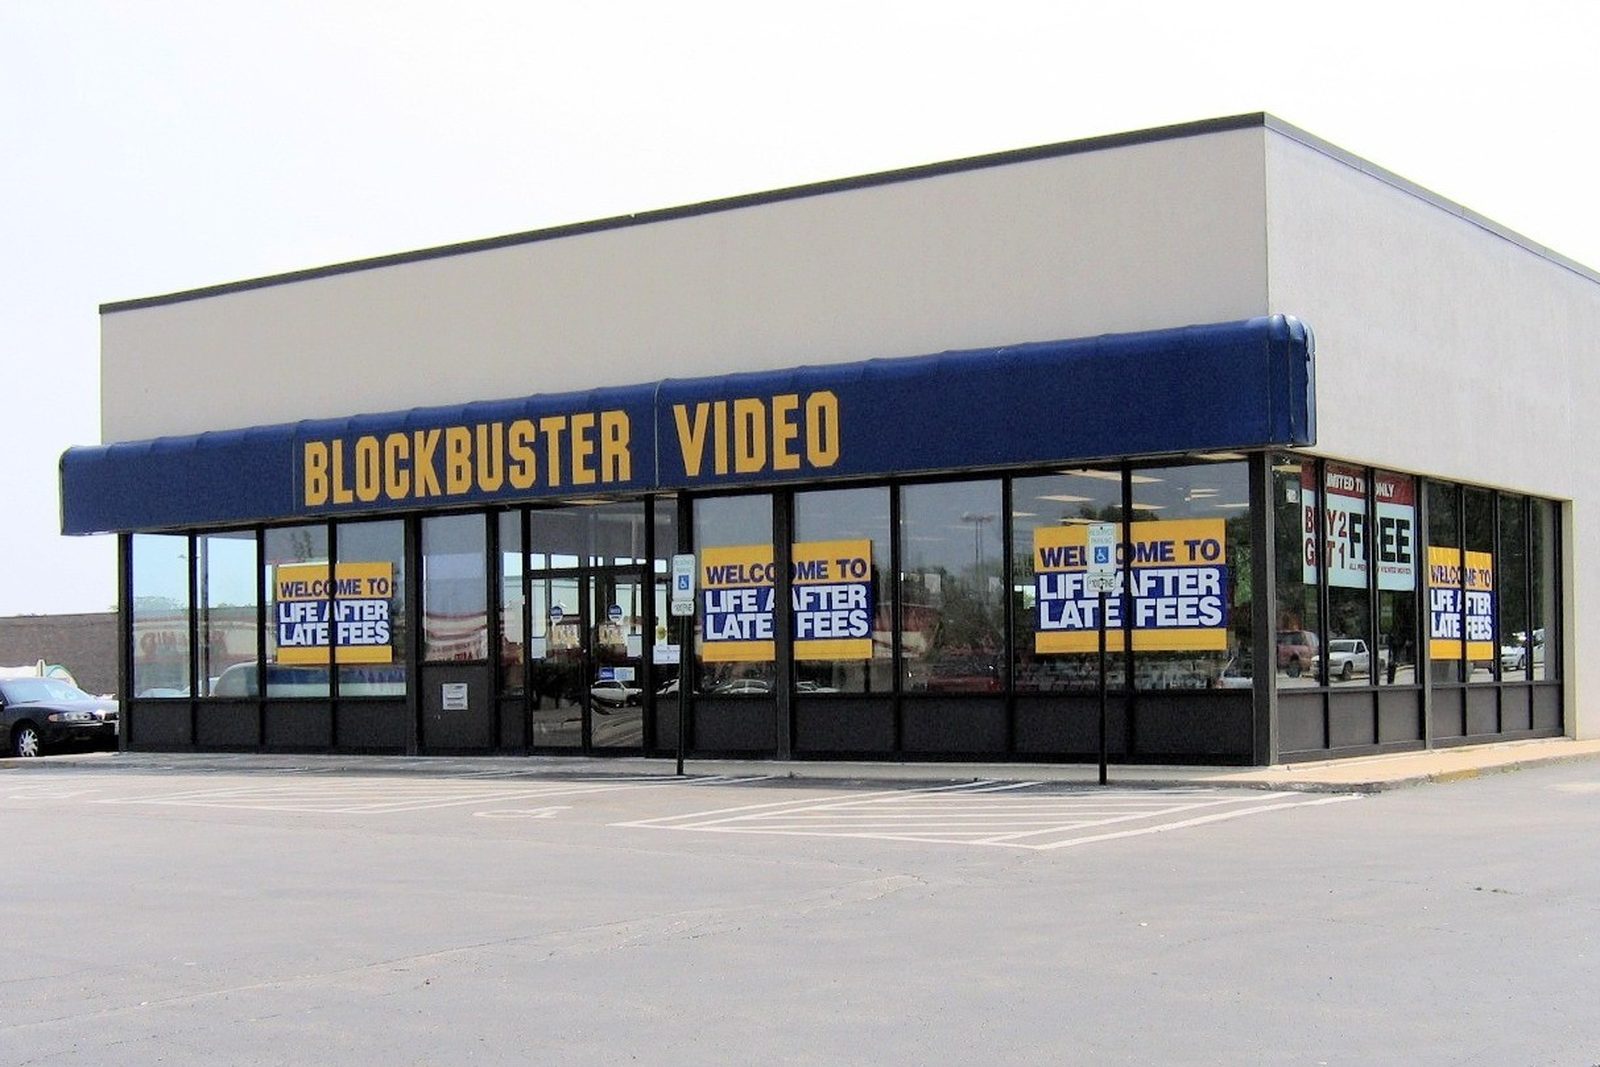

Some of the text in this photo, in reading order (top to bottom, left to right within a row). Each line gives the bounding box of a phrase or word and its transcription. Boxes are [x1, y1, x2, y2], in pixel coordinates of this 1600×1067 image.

[304, 391, 840, 506] BLOCKBUSTER VIDEO
[1305, 505, 1347, 538] BY 2
[1040, 538, 1221, 567] WELOME TO
[1305, 537, 1345, 569] GT 1
[706, 558, 867, 584] WELCOME TO
[1111, 568, 1221, 597] AFTER
[1479, 569, 1491, 588] TO
[368, 578, 389, 596] TO
[705, 584, 867, 613] LIFE AFTER
[1431, 589, 1454, 612] LIFE
[280, 600, 389, 622] LIFE AFTER
[706, 609, 869, 640] LATE FEES
[1040, 596, 1222, 629] LATE FEES
[280, 621, 390, 646] LATE FEES
[1431, 612, 1492, 640] LATE FEES
